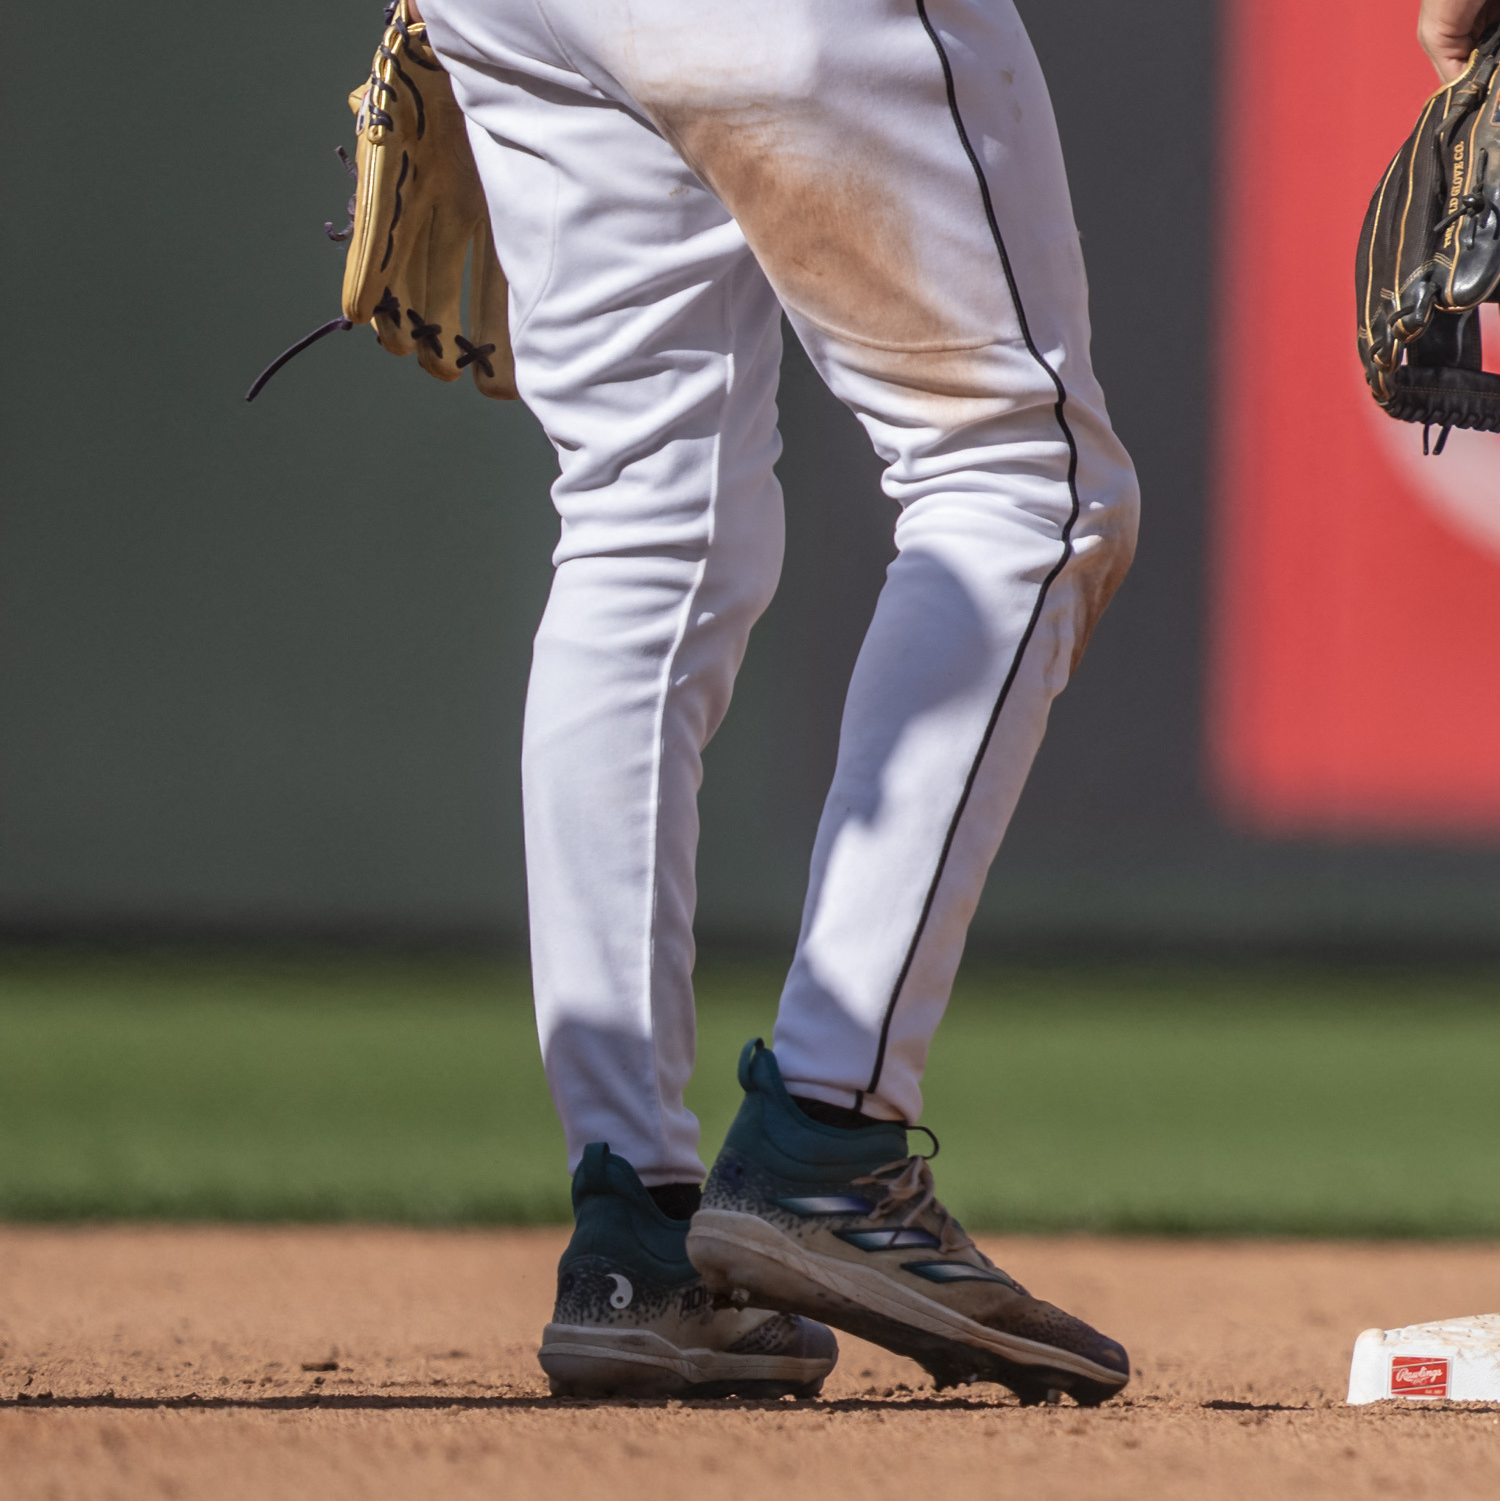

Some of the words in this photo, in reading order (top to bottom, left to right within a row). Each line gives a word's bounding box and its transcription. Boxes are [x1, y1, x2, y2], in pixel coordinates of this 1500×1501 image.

[1454, 141, 1464, 161] CO.
[1450, 161, 1464, 197] GLOVE
[1396, 1366, 1443, 1382] Rawlings
